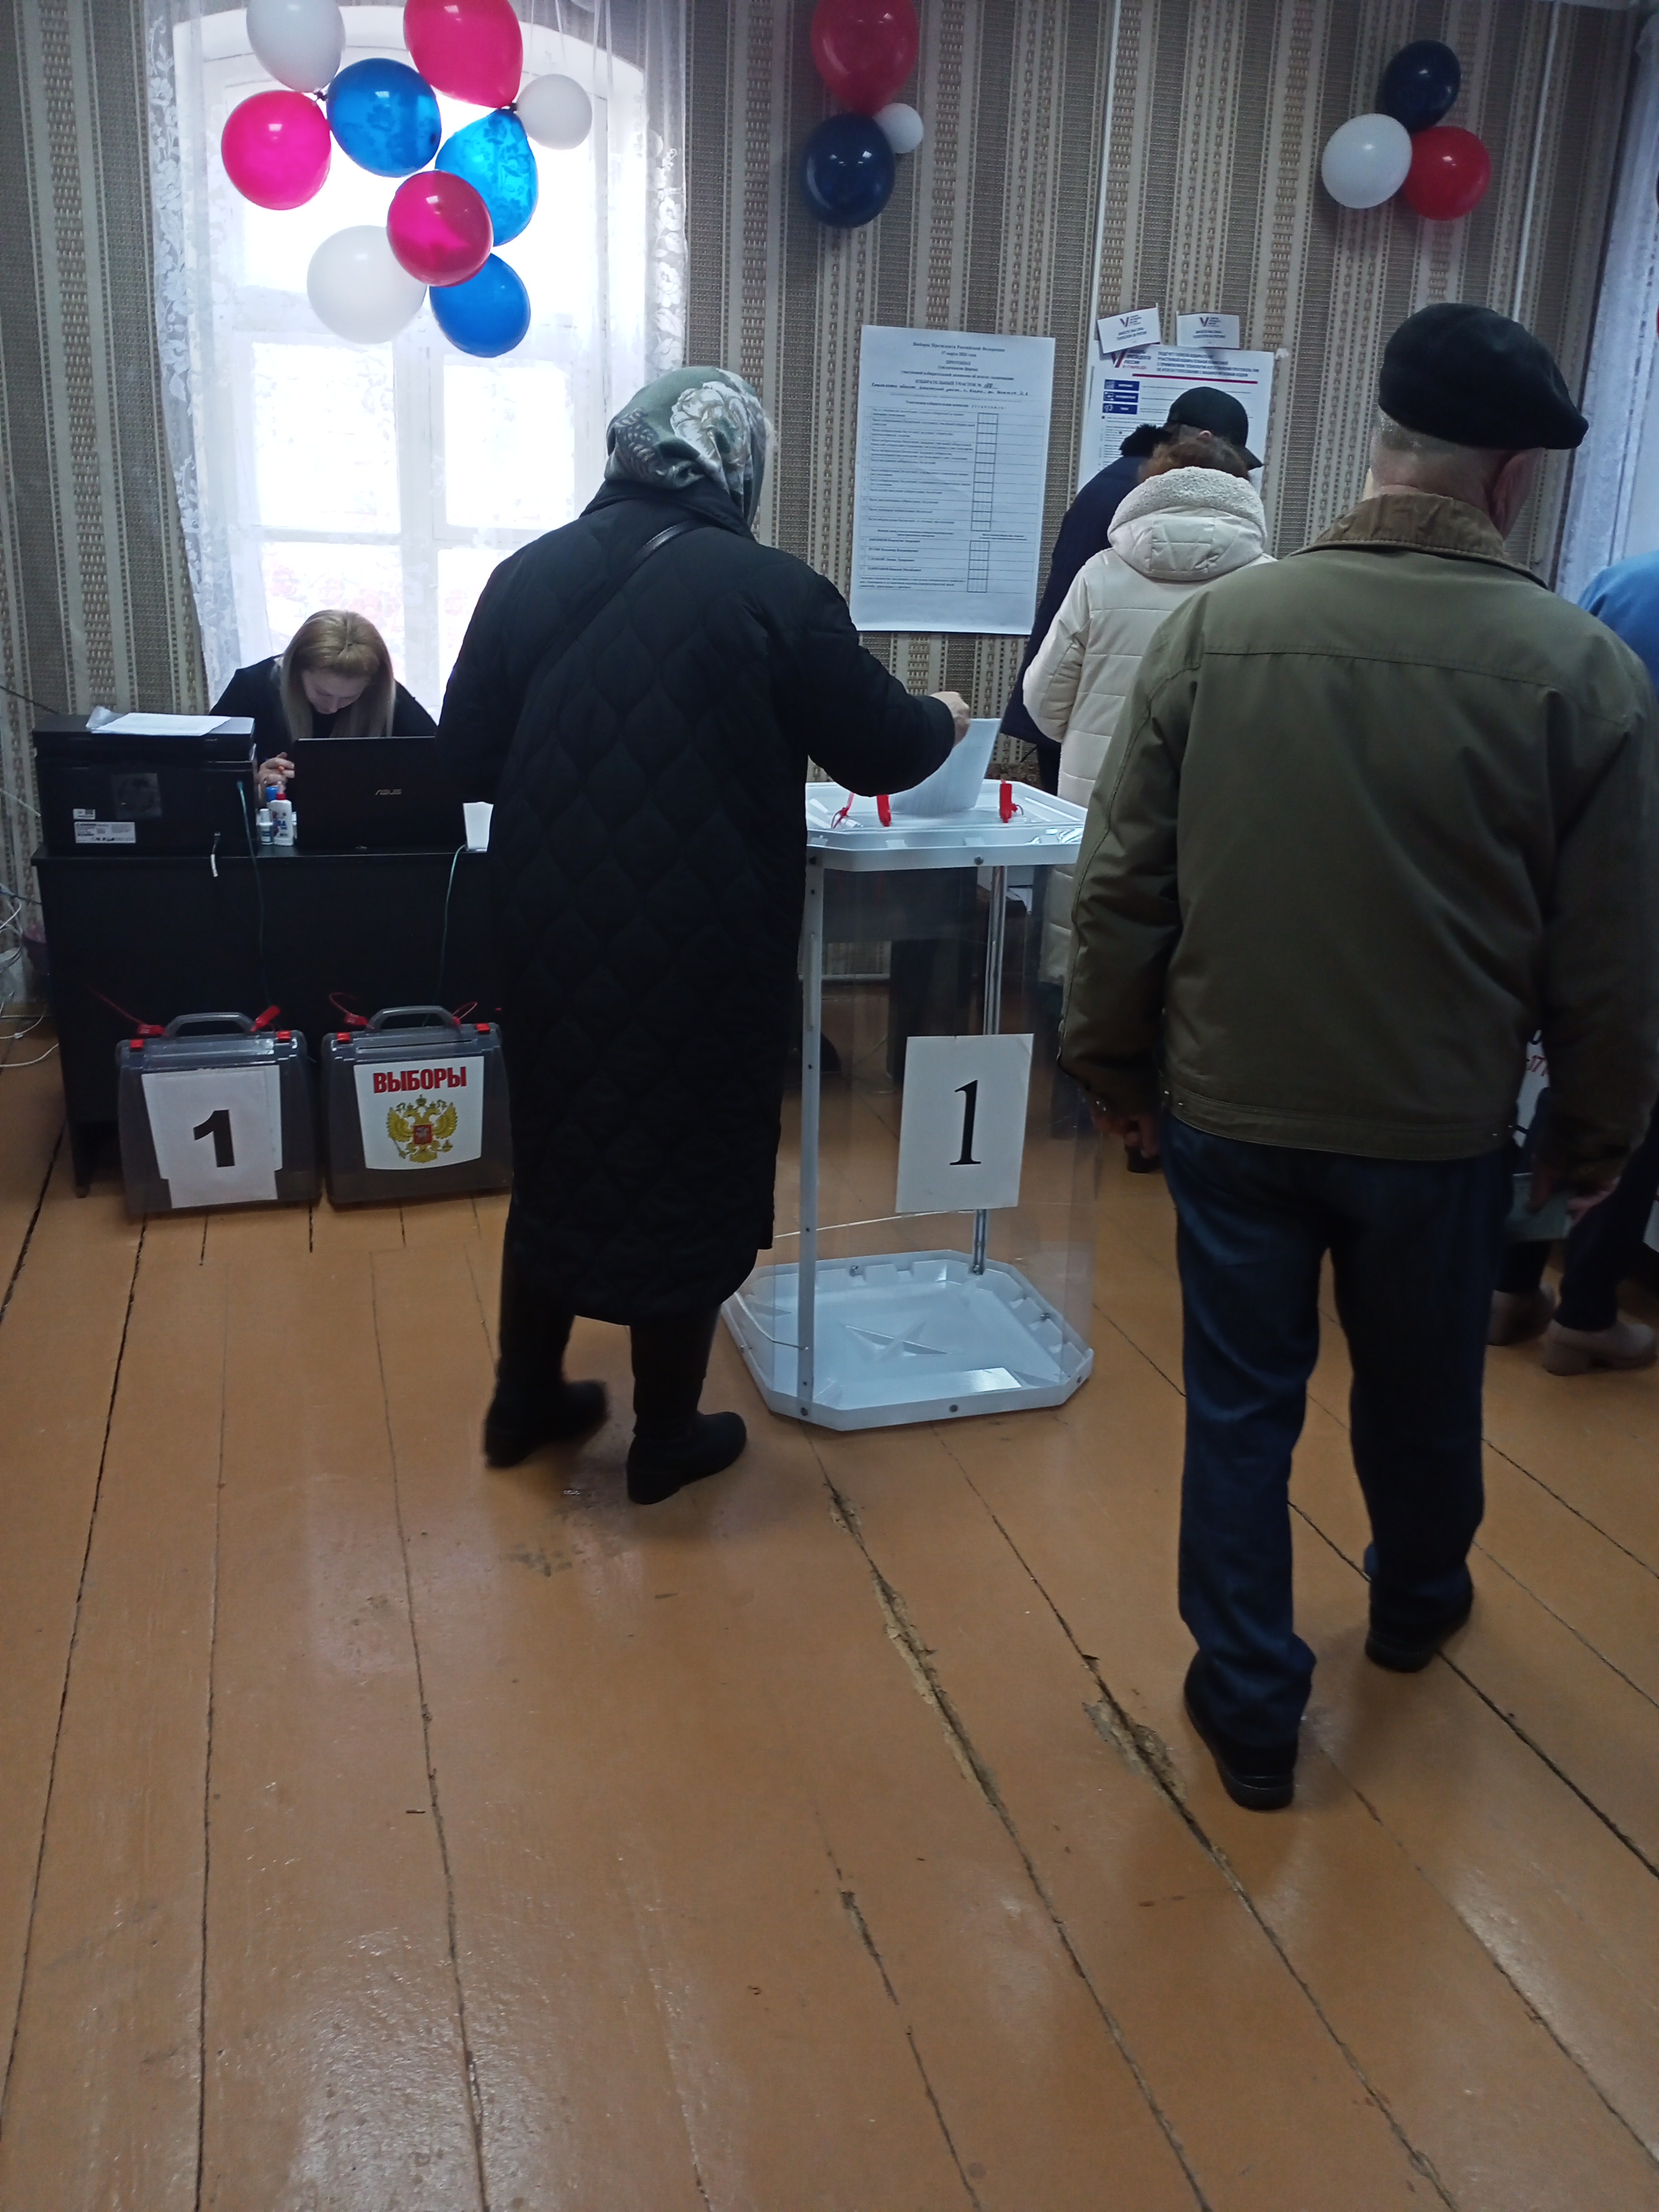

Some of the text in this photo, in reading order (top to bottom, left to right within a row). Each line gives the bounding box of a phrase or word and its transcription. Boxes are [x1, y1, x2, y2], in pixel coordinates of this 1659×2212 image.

[374, 1067, 467, 1093] ВЫБОРЫ
[193, 1109, 235, 1168] 1
[950, 1079, 981, 1166] 1
